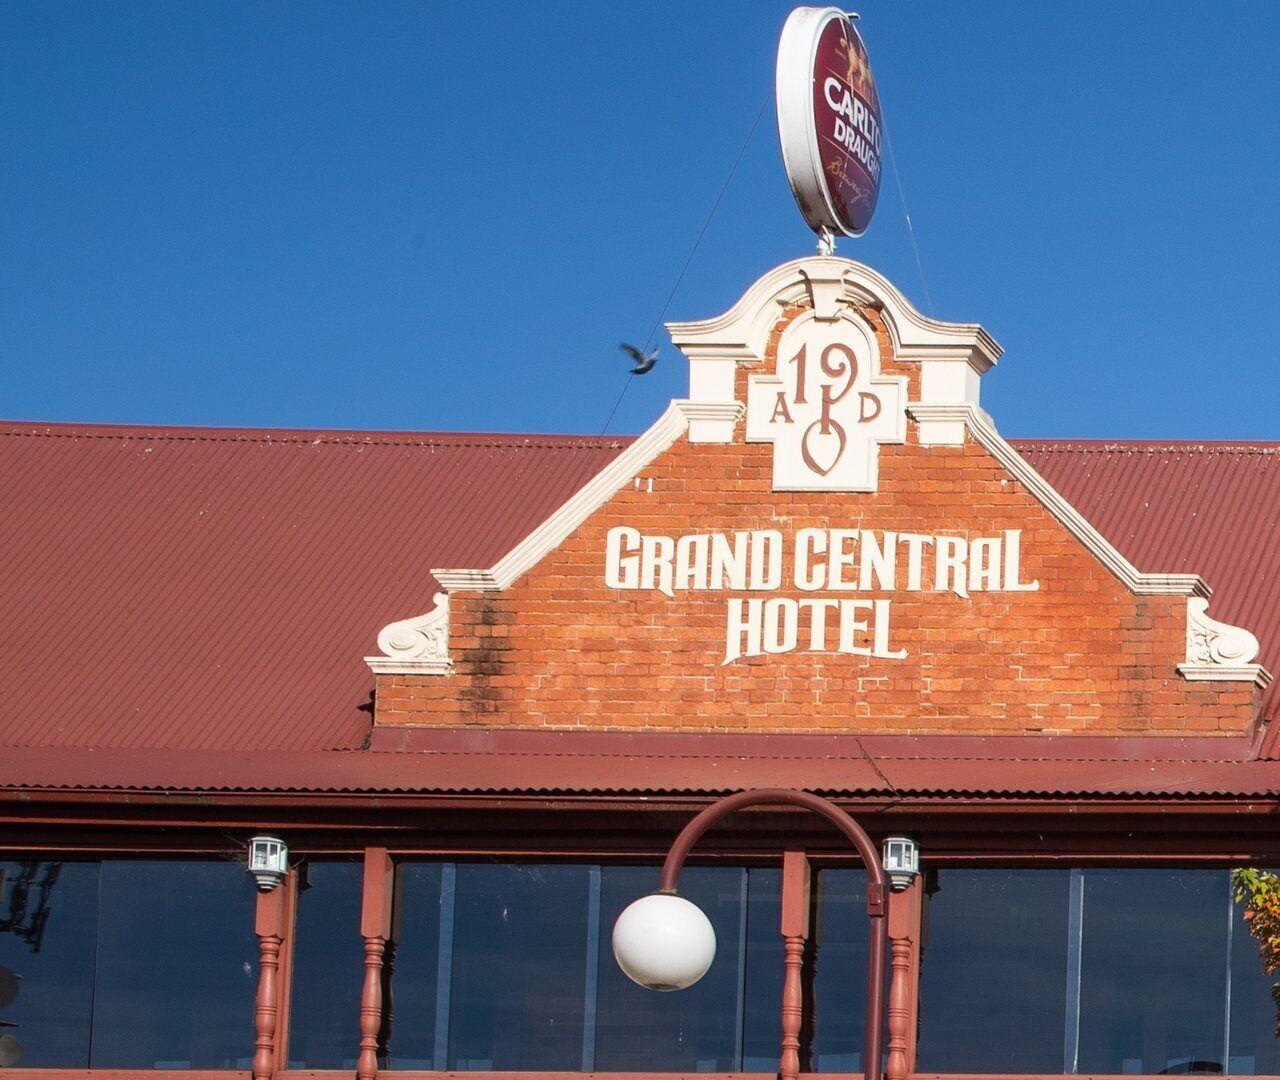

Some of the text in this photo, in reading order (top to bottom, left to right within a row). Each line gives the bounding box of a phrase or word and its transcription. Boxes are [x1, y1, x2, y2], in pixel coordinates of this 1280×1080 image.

[770, 392, 794, 424] A
[858, 391, 882, 424] D
[605, 526, 1041, 599] GRAND CENTRAL
[721, 597, 909, 667] HOTEL
